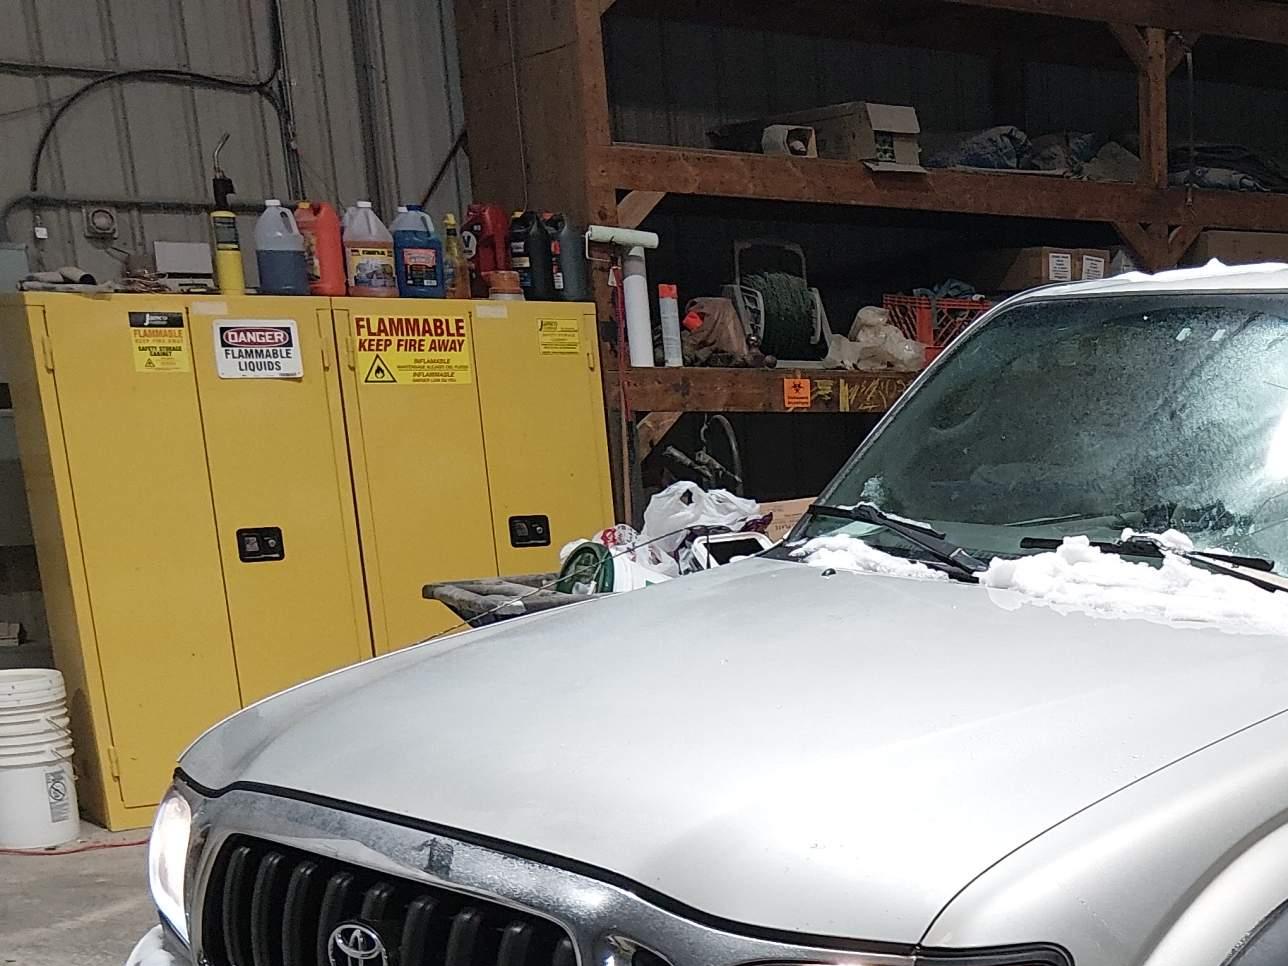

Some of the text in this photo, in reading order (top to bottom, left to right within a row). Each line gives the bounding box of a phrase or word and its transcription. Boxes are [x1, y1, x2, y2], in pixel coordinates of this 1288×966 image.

[355, 317, 466, 337] FLAMMABLE
[227, 332, 285, 343] DANGER
[358, 339, 465, 352] KEEP FIRE AWAY
[224, 349, 293, 360] FLAMMABLE
[238, 361, 282, 372] LIQUIDS
